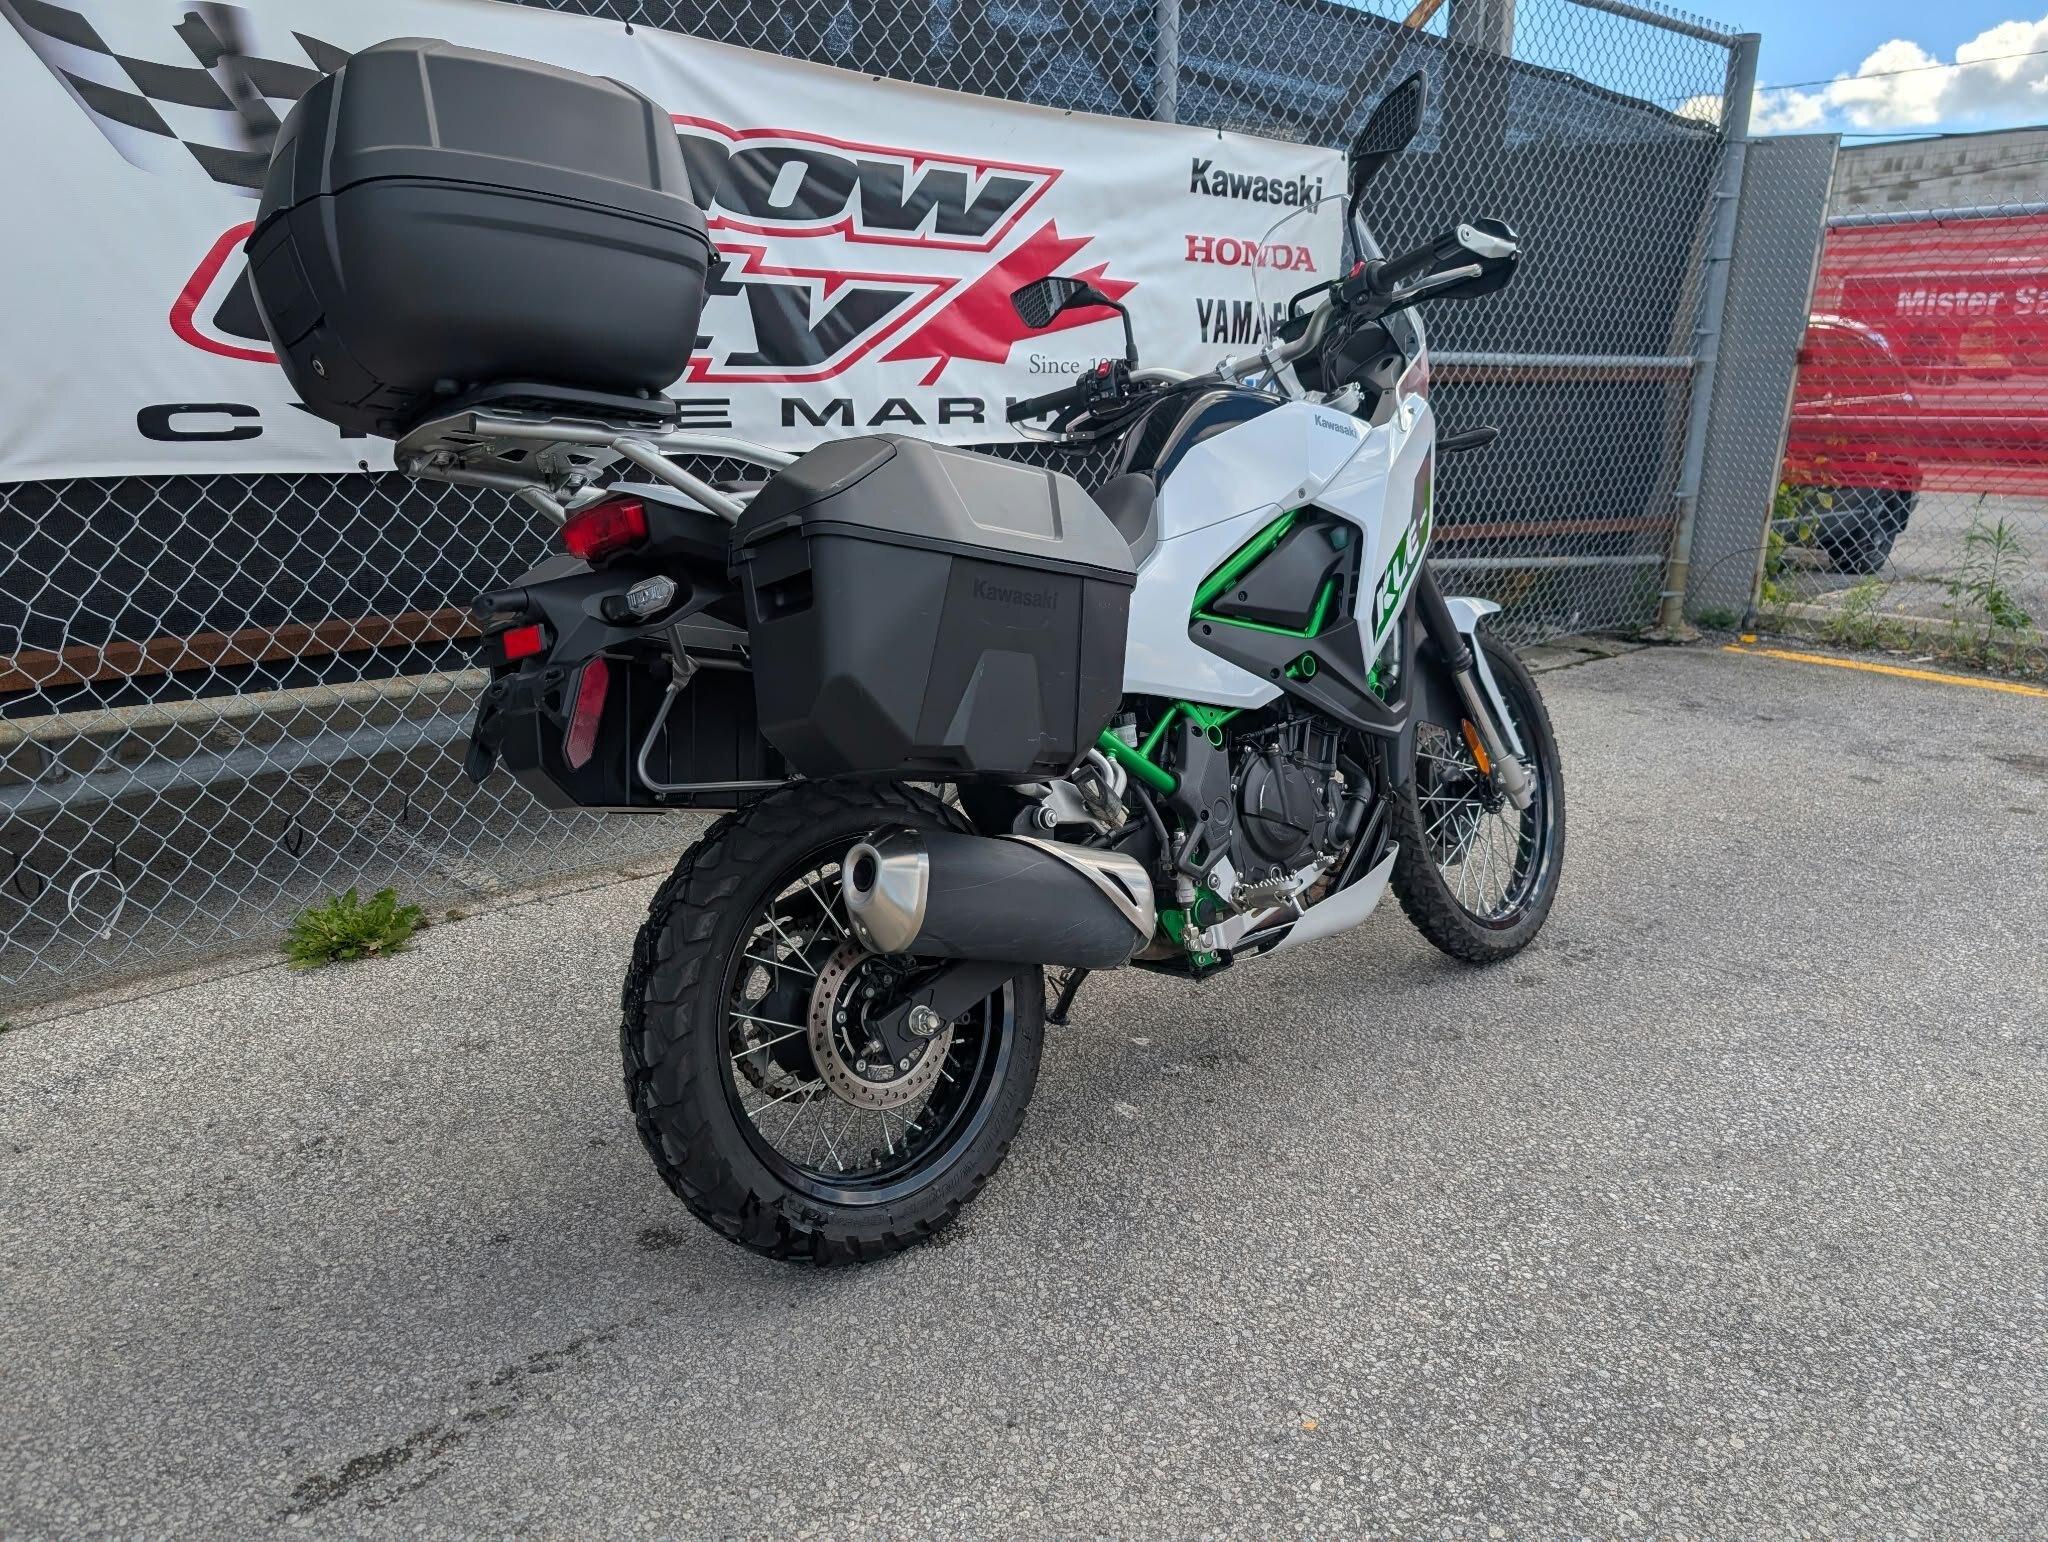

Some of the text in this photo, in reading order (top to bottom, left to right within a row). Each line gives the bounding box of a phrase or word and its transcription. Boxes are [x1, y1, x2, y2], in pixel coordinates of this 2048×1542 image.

[676, 133, 1035, 237] OW
[1190, 157, 1323, 215] Kawasaki
[1184, 234, 1318, 273] HONDA
[1195, 297, 1304, 345] YAMA
[1896, 288, 2005, 316] Mister
[1029, 353, 1080, 374] Since
[1314, 413, 1358, 439] Kawasaki
[1377, 518, 1420, 619] KLE
[973, 579, 1058, 609] Kawasaki
